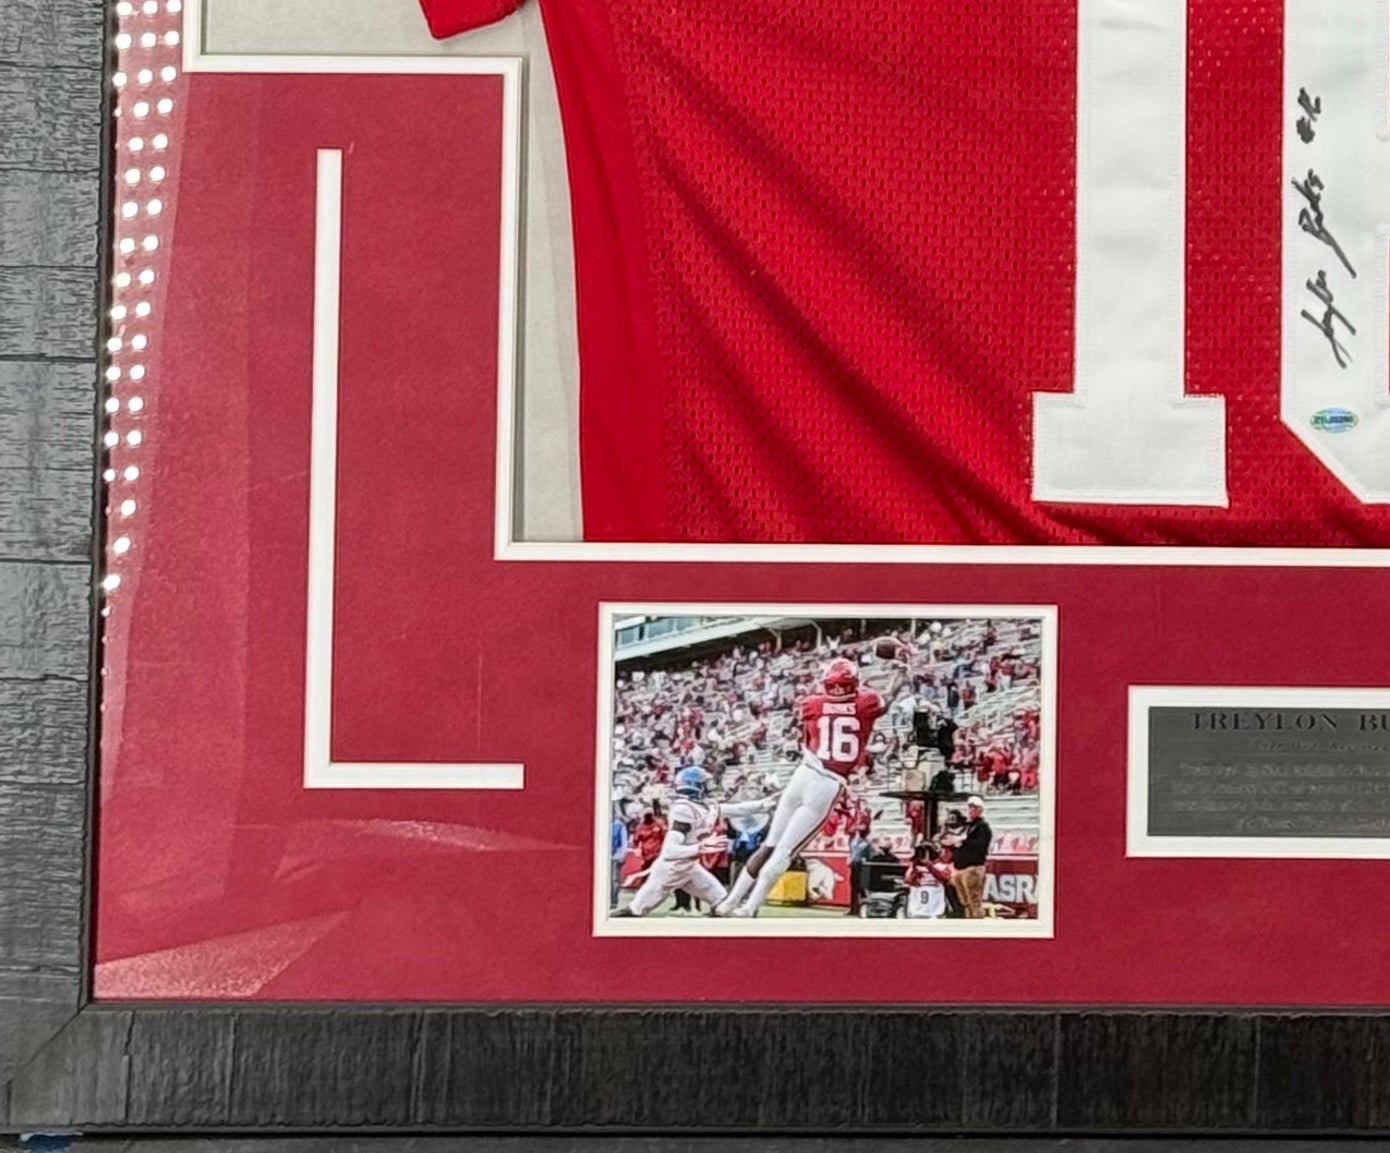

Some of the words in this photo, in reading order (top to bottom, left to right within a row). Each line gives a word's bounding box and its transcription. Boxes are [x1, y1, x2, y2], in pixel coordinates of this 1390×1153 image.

[1190, 712, 1337, 731] TREYLON
[817, 715, 861, 762] 16
[982, 873, 1039, 904] ASR
